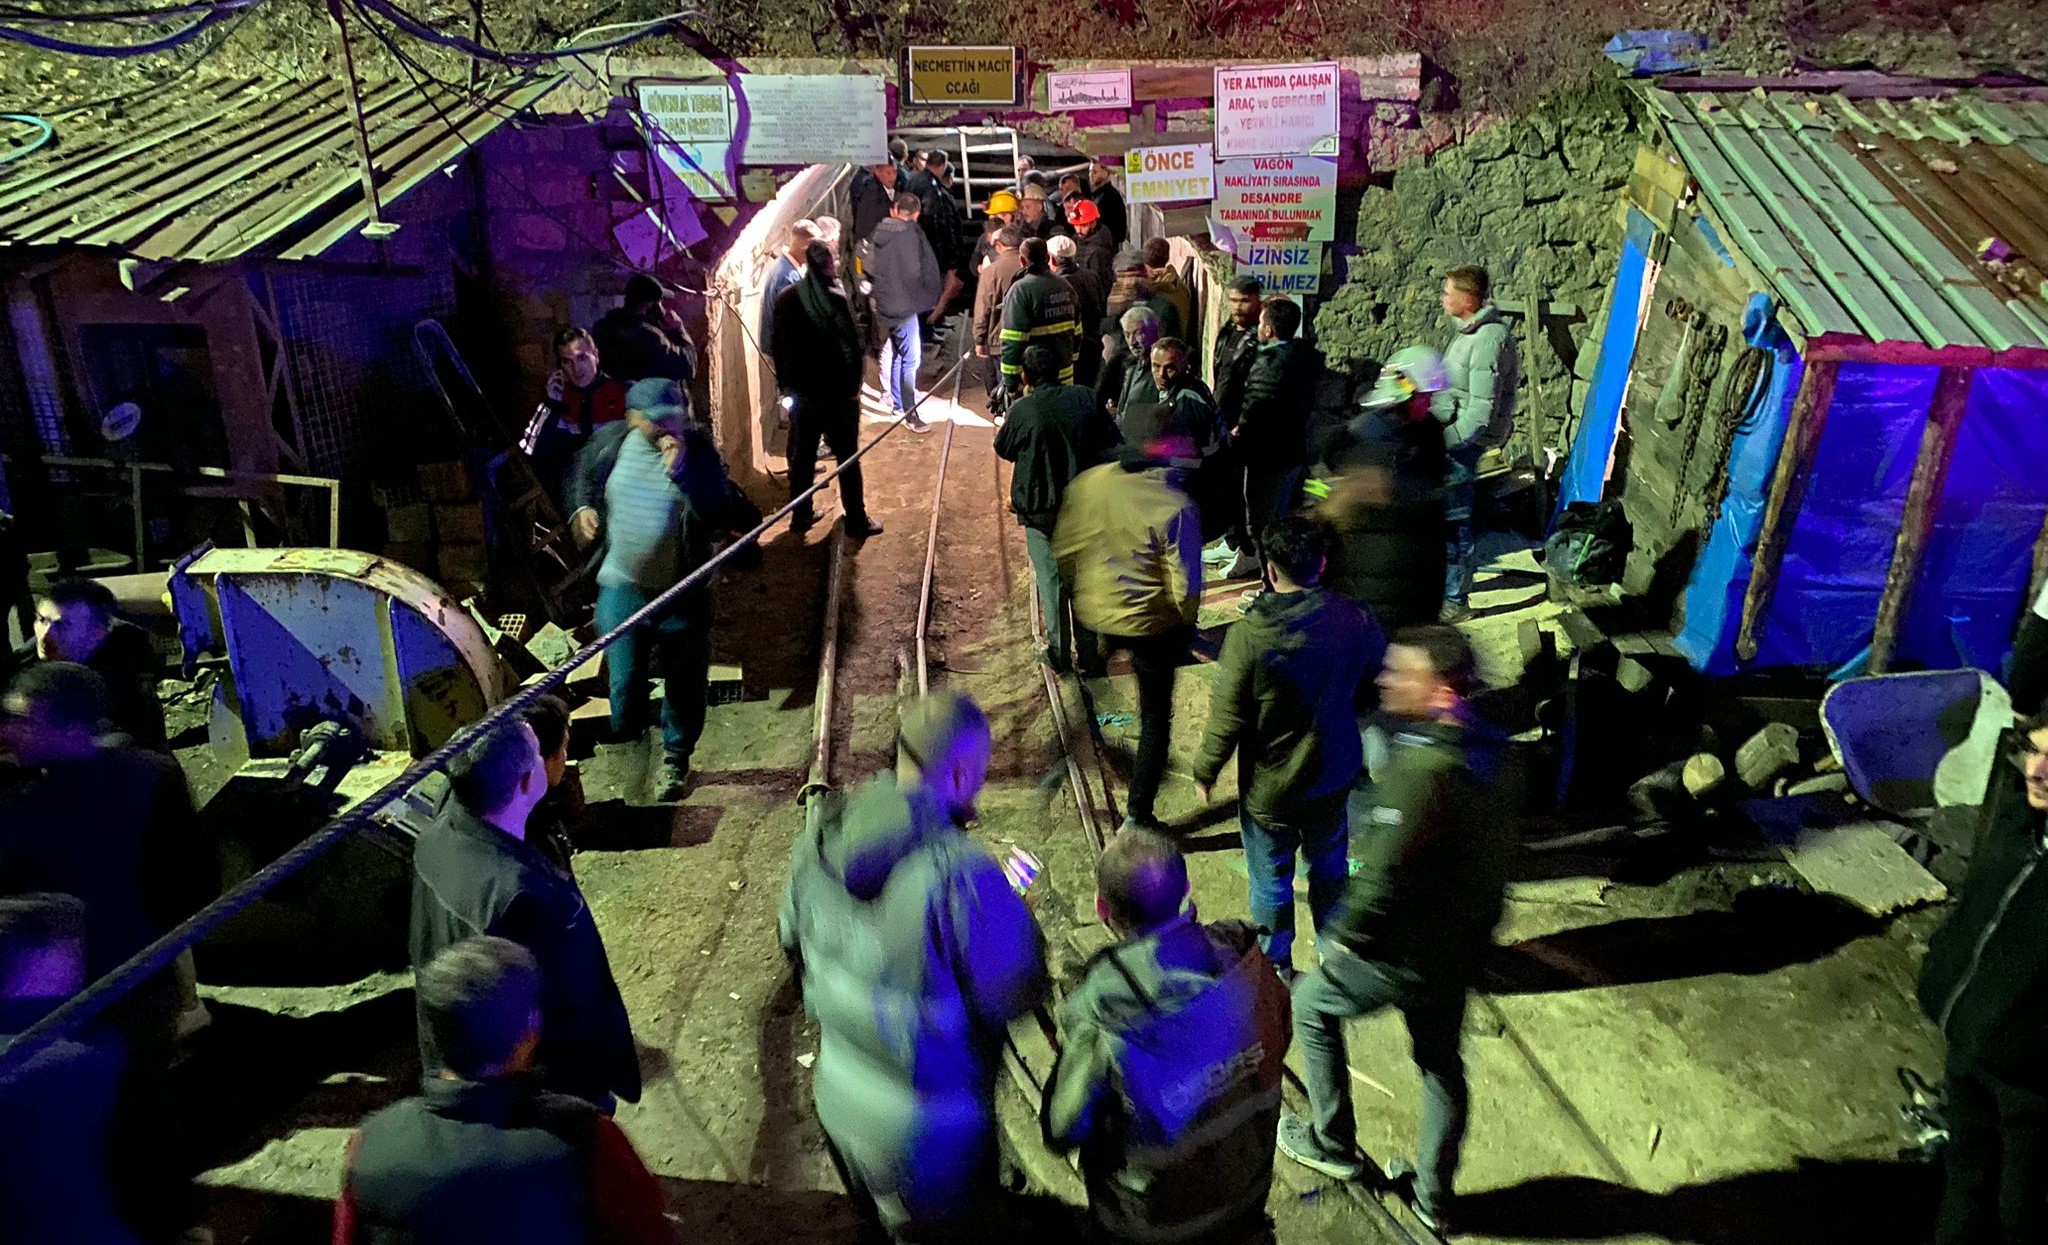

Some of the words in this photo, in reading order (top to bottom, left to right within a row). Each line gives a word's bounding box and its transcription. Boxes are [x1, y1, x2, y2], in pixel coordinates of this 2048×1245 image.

[914, 58, 975, 72] NECMETTİN
[978, 58, 1011, 72] MACİT
[1223, 77, 1242, 90] YER
[1245, 75, 1286, 89] ALTINDA
[1289, 73, 1332, 90] ÇALIŞAN
[1228, 98, 1255, 112] ARAÇ
[1258, 100, 1269, 109] ve
[1144, 150, 1195, 172] ÖNCE
[1253, 159, 1293, 170] VAGON
[1224, 174, 1271, 187] NAKLİYATI
[1273, 176, 1321, 187] SIRASINDA
[1241, 193, 1302, 204] DESANDRE
[1220, 209, 1270, 220] TABANINDA
[1272, 209, 1322, 220] BULUNMAK
[1248, 245, 1310, 265] İZİNSİZ
[1248, 271, 1317, 290] RİLMEZ
